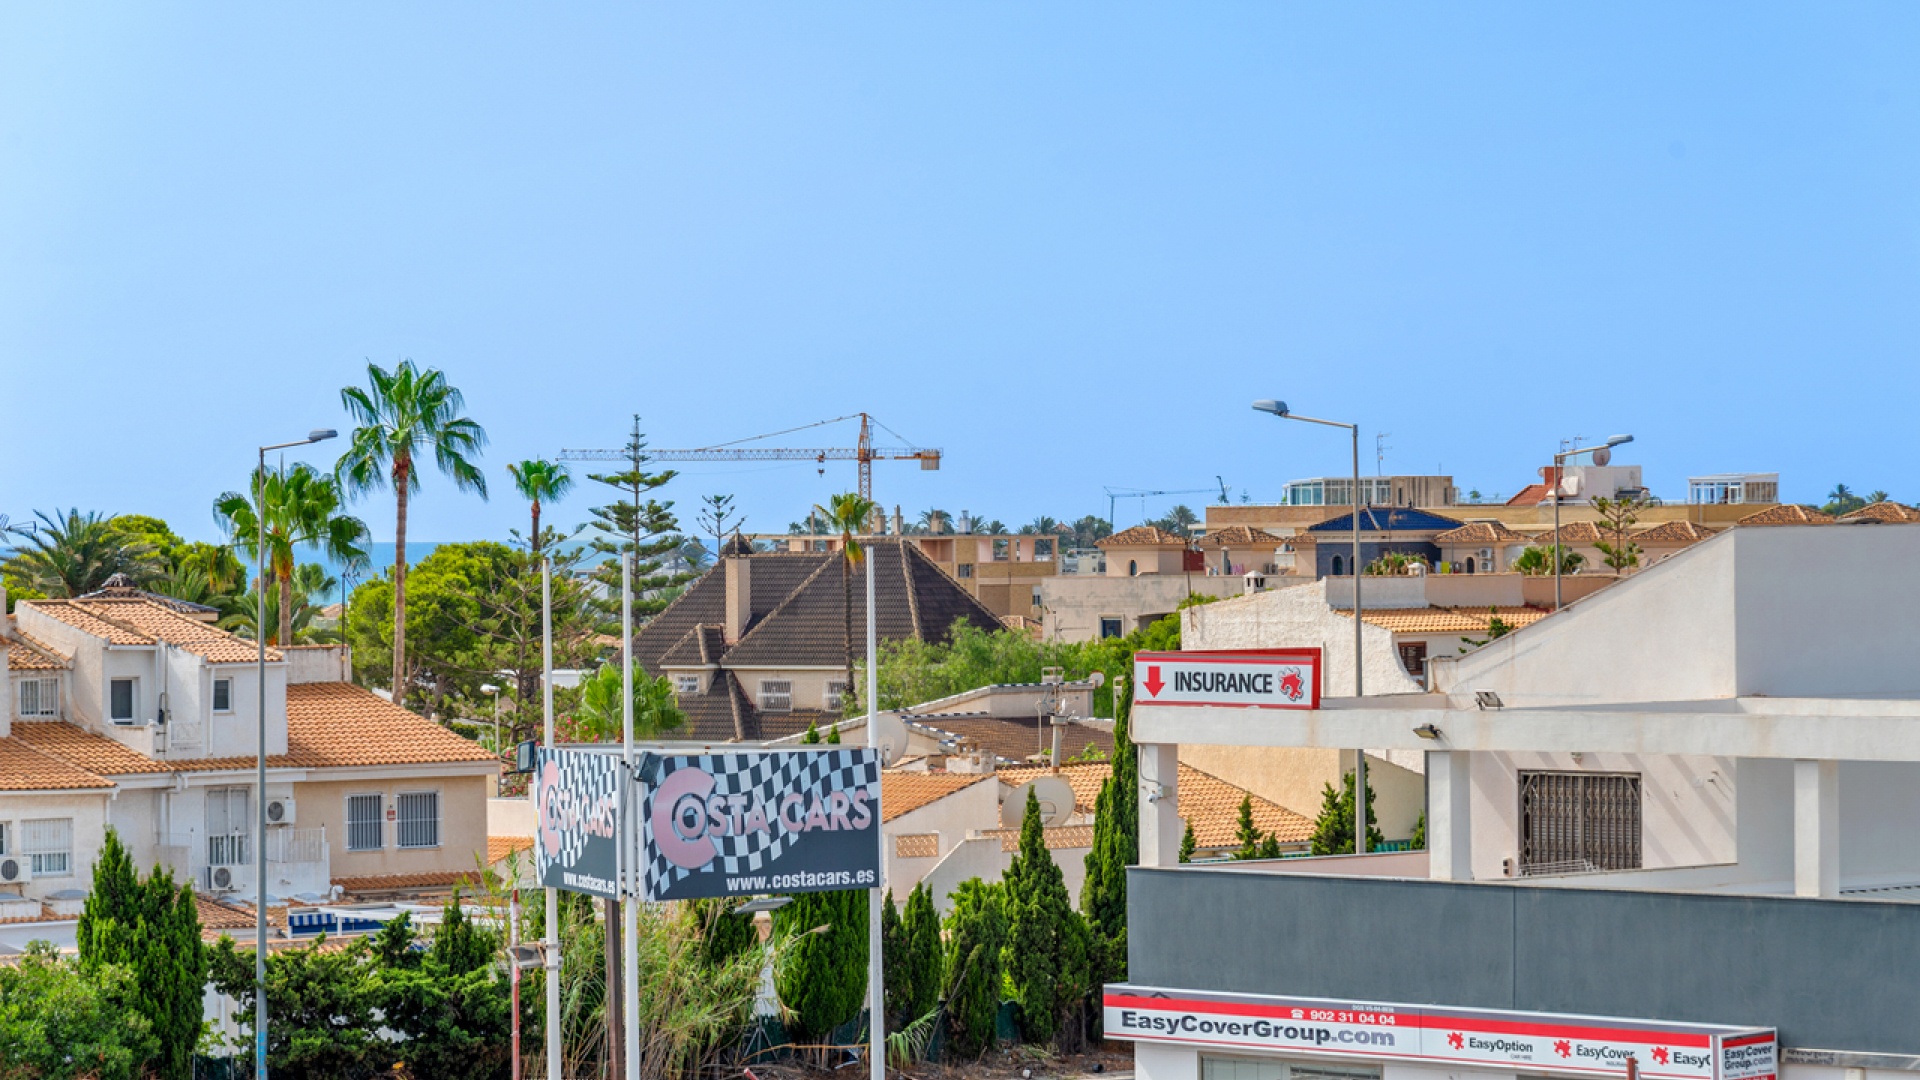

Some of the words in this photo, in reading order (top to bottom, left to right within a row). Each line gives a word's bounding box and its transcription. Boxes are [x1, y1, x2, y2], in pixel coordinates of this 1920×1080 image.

[1174, 671, 1273, 694] INSURANCE
[581, 794, 614, 840] CARS
[651, 766, 771, 870] COSTA
[780, 788, 872, 833] CARS
[563, 871, 616, 895] www.costacars.es
[726, 869, 875, 892] www.costacars.es
[1121, 1010, 1396, 1047] EasyCoverGroup.com
[1310, 1009, 1335, 1022] 902
[1338, 1011, 1354, 1023] 31
[1358, 1013, 1376, 1024] 04
[1379, 1014, 1396, 1025] 04
[1469, 1037, 1533, 1052] EasyOption
[1576, 1044, 1635, 1060] EasyCover
[1724, 1045, 1773, 1060] EasyCover
[1724, 1056, 1773, 1070] Group.com
